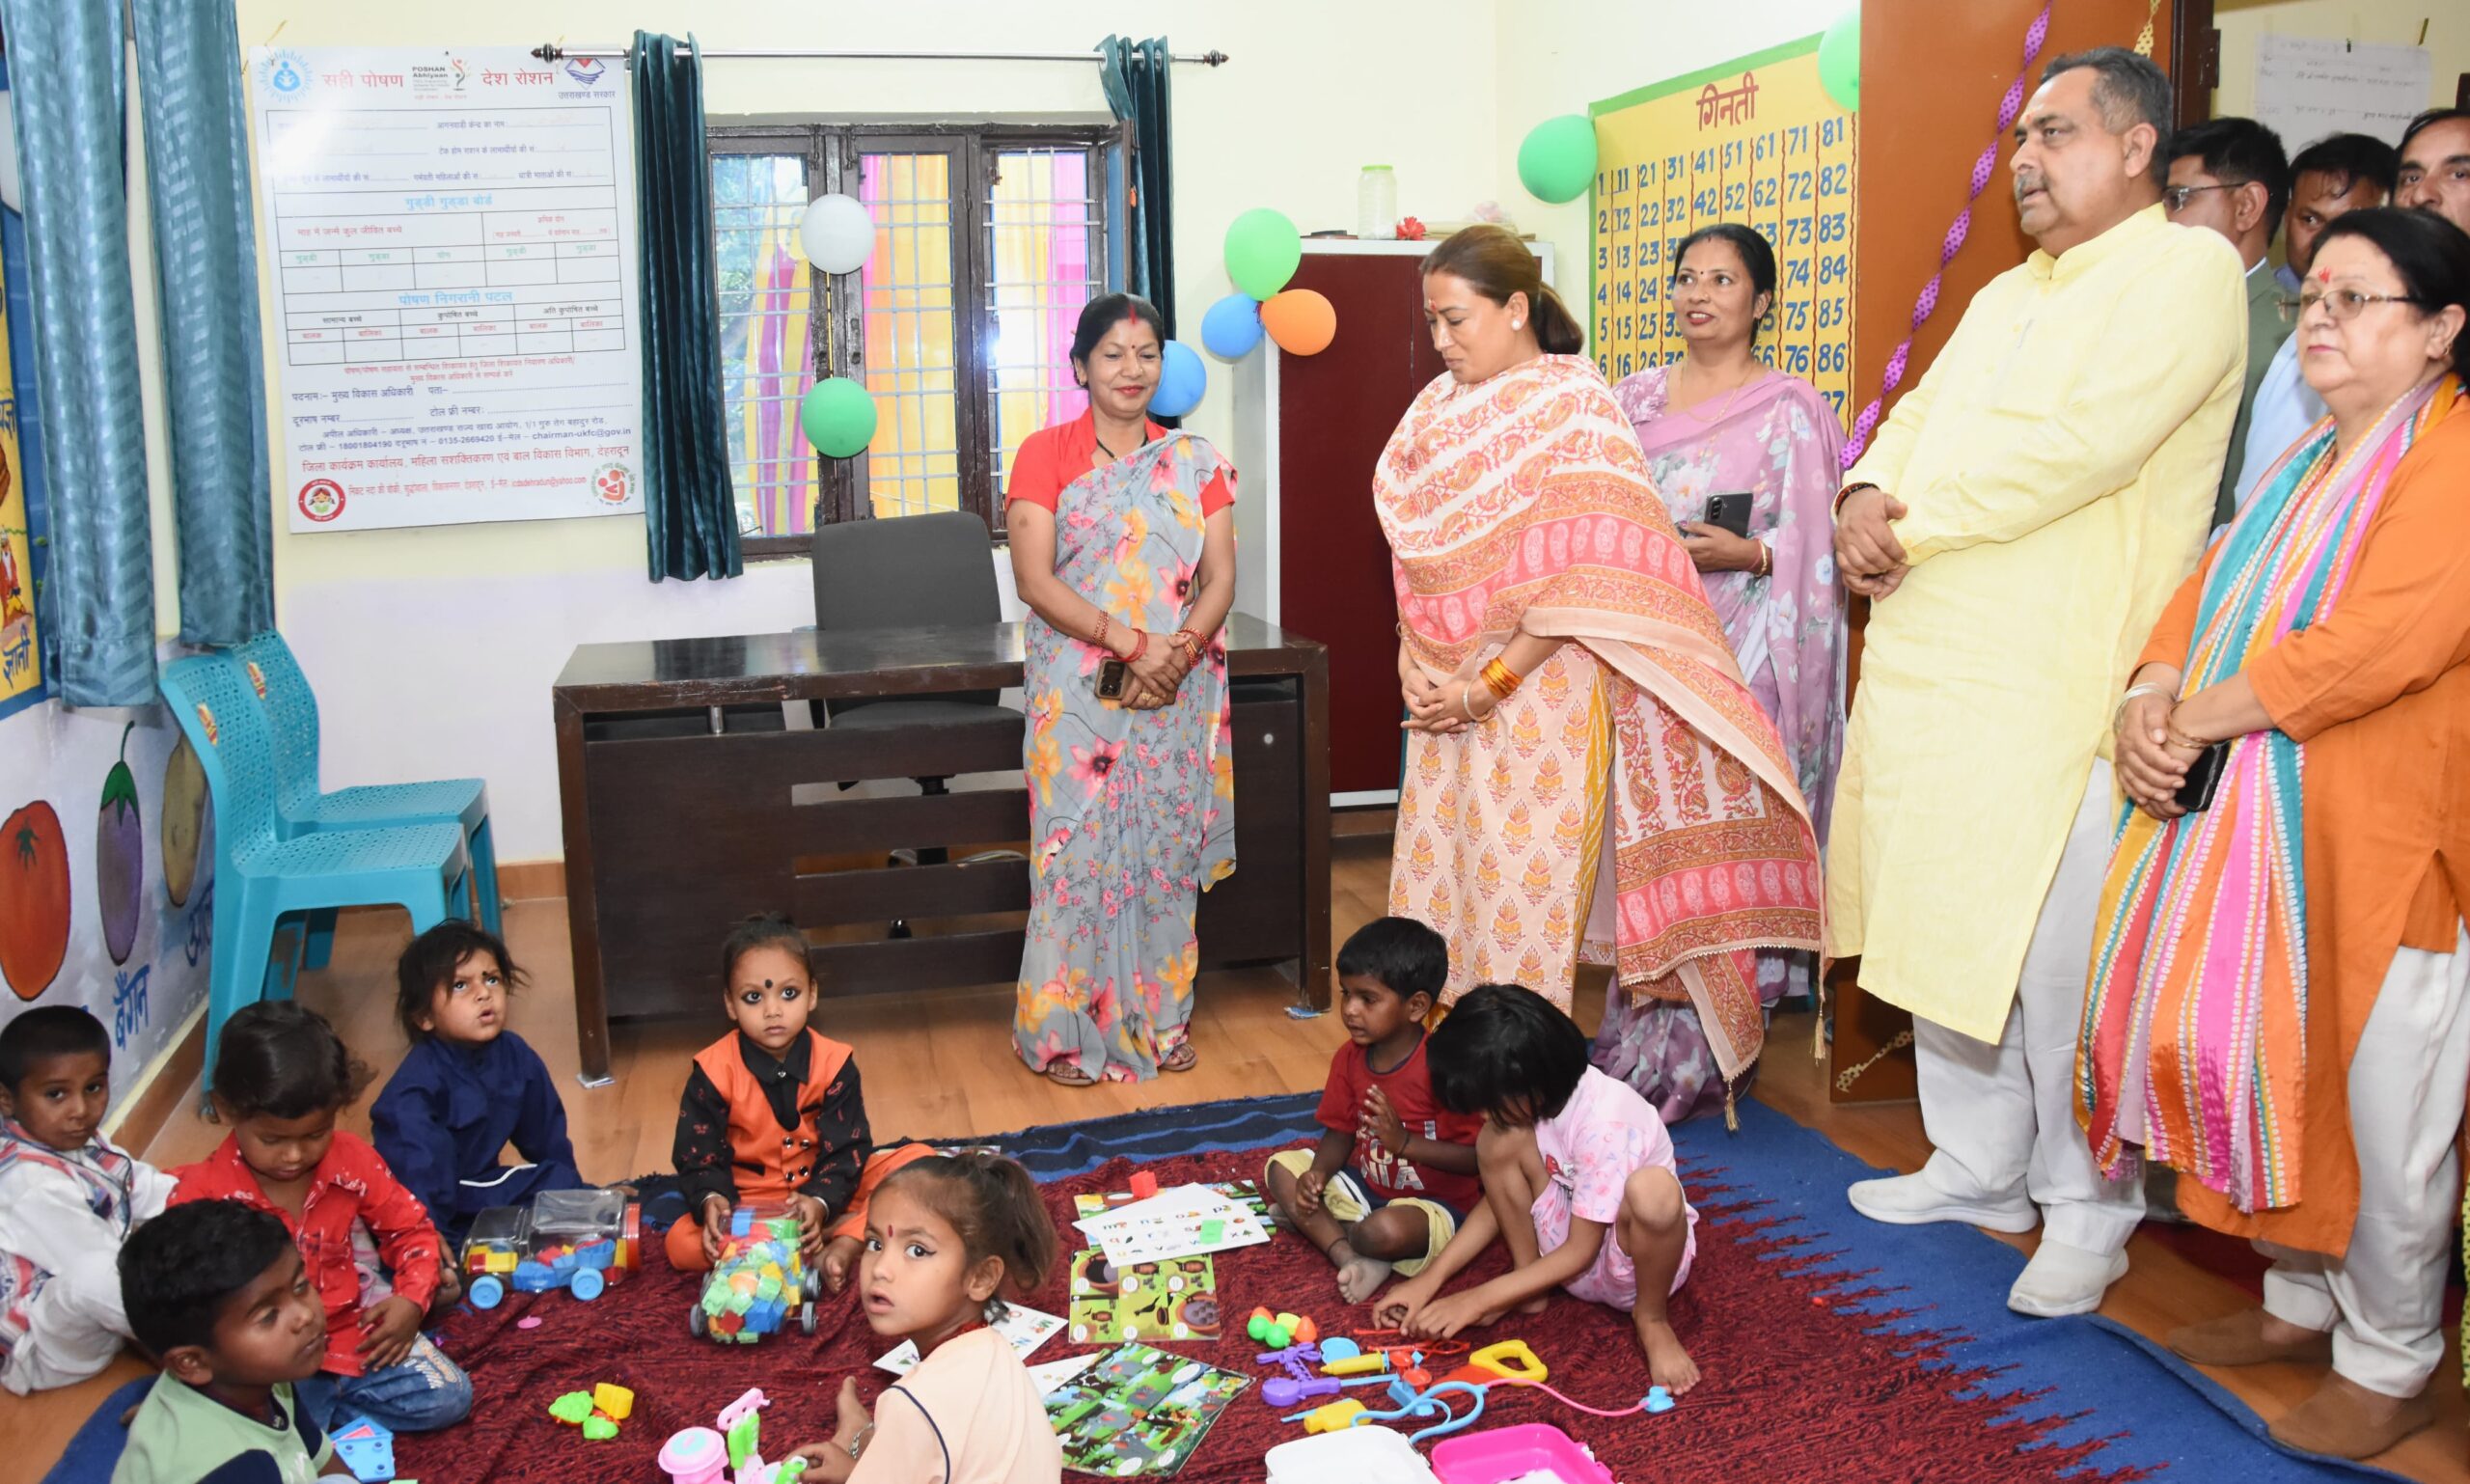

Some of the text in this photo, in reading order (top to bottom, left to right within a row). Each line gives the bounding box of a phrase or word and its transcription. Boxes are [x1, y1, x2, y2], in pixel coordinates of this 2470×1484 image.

[361, 69, 403, 88] पोषण
[480, 69, 508, 86] देश
[513, 69, 553, 85] रोशन
[1696, 70, 1759, 131] गिनती
[1599, 117, 1843, 196] 1 11 21 31 41 51 61 71 81
[1599, 163, 1847, 234] 2 12 22 32 42 52 62 72 82
[1786, 216, 1812, 246] 73
[1819, 212, 1846, 243] 83
[1598, 247, 1607, 270] 3
[1616, 245, 1630, 268] 13
[1639, 241, 1660, 266] 23
[1787, 254, 1848, 289] 74 84
[398, 289, 513, 305] पोषण निगरानी पटल
[1598, 278, 1657, 305] 4 14 24
[544, 305, 557, 314] अति
[1786, 297, 1845, 332] 75 85
[1600, 317, 1607, 342] 5
[1616, 316, 1632, 340] 15
[1639, 313, 1658, 340] 25
[1599, 353, 1607, 377] 6
[1616, 353, 1632, 377] 16
[1785, 343, 1846, 373] 76 86
[331, 391, 348, 403] मुख्य
[352, 388, 378, 398] विकास
[381, 385, 413, 398] अधिकारी
[291, 415, 340, 426] दूरभाष नम्बर
[429, 408, 445, 417] टोल
[448, 404, 458, 416] फ्री
[532, 427, 631, 440] chairman-ukfc@gov.in
[302, 459, 326, 472] जिला
[328, 457, 364, 471] कार्यक्रम
[409, 454, 437, 467] महिला
[441, 453, 494, 465] सशक्तिकरण
[512, 452, 531, 461] बाल
[534, 447, 562, 460] विकास
[597, 445, 629, 458] देहरादून
[3, 623, 31, 690] ज्ञानी
